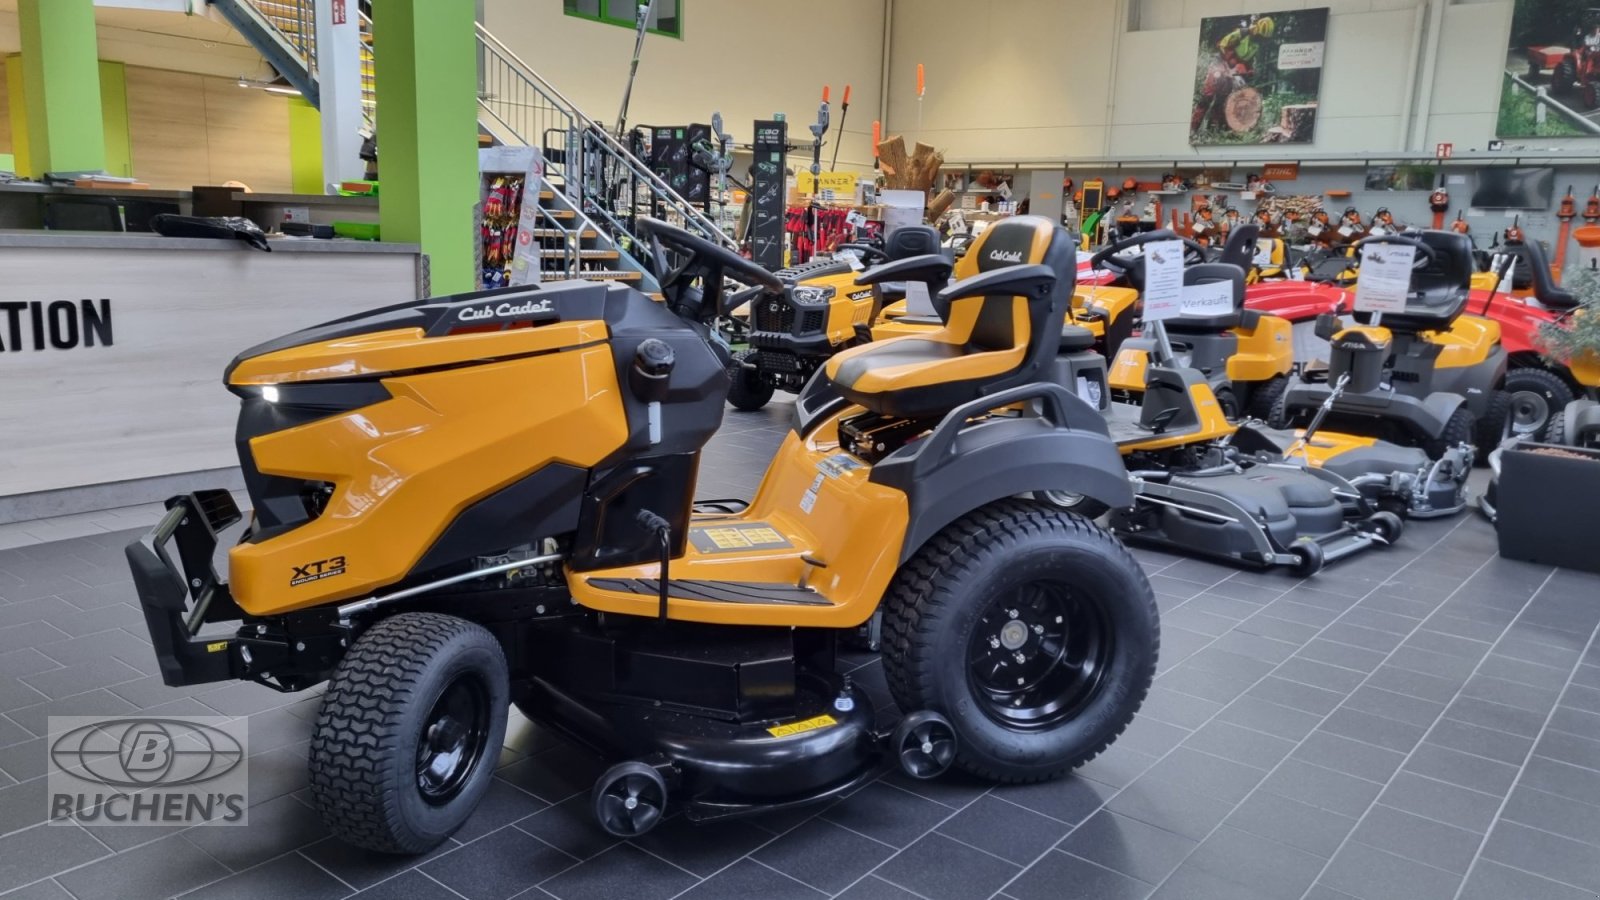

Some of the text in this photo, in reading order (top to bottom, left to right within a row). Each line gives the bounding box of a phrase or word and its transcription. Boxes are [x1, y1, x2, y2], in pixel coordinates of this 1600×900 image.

[807, 177, 849, 185] PANNER
[990, 249, 1002, 260] Cub
[1183, 294, 1229, 308] Verkauft
[458, 299, 552, 320] Cub Cadet
[0, 299, 113, 352] TION
[291, 556, 346, 580] XT3
[291, 569, 342, 585] ENDURO SERIES
